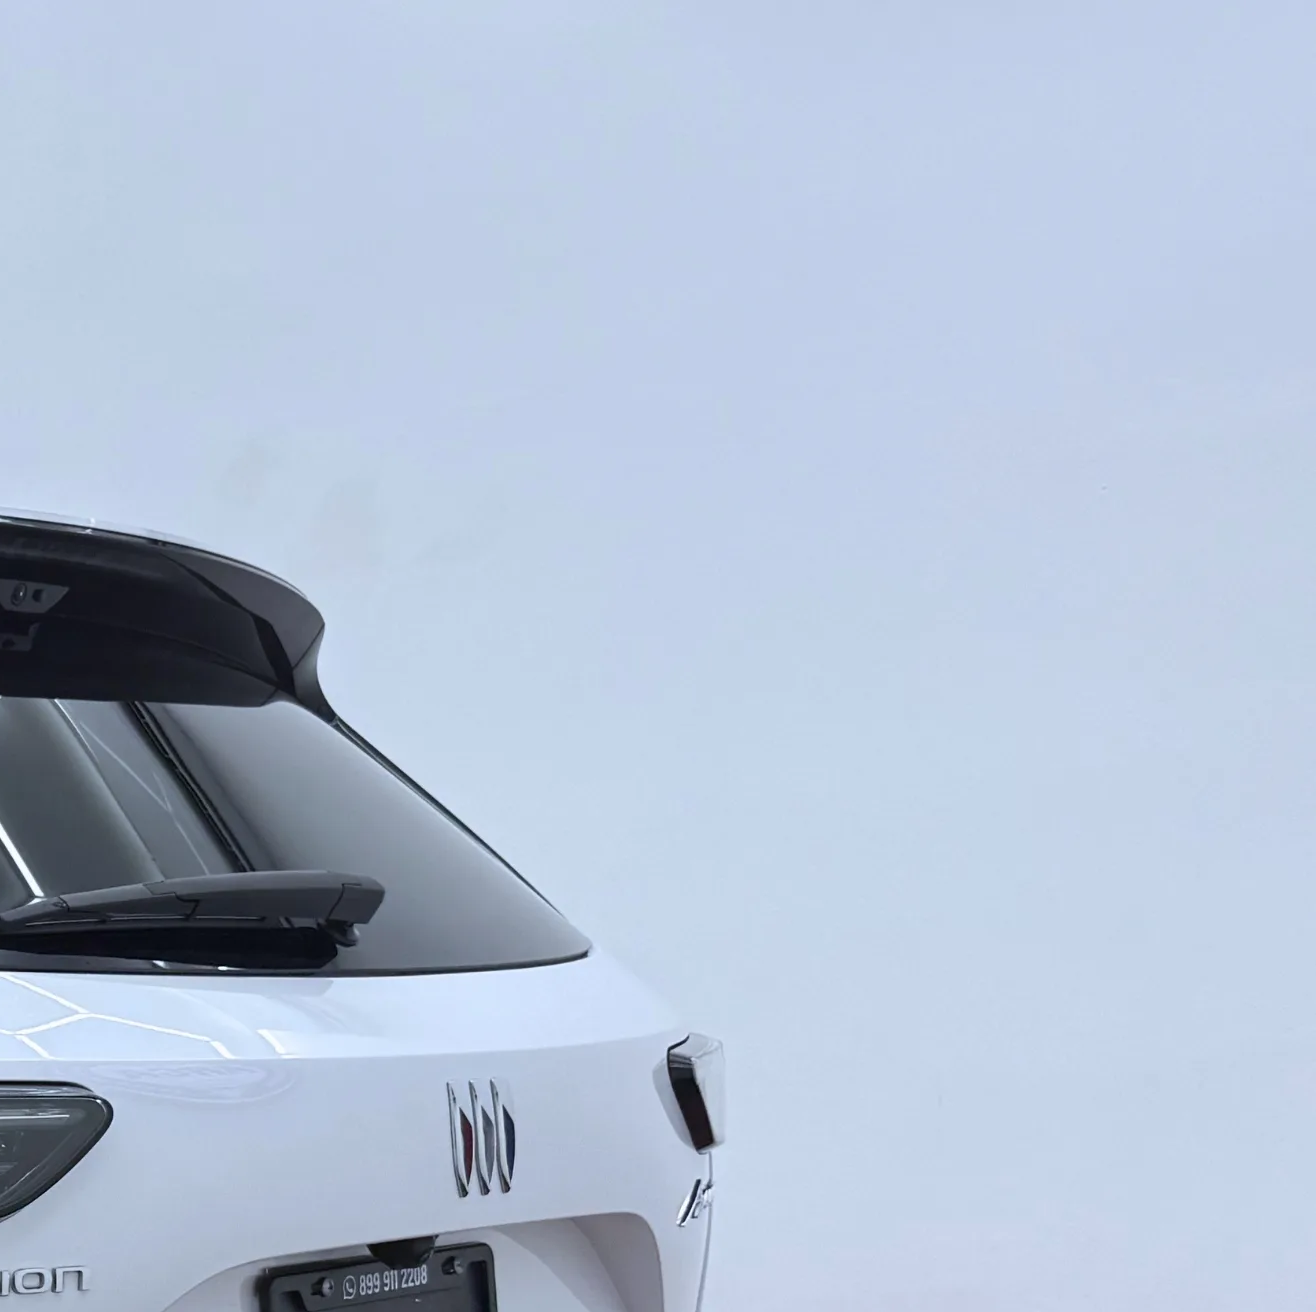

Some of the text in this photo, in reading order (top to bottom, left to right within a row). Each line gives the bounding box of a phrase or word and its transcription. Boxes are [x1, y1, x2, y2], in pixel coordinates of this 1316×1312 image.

[359, 1266, 428, 1296] 899 911 2208
